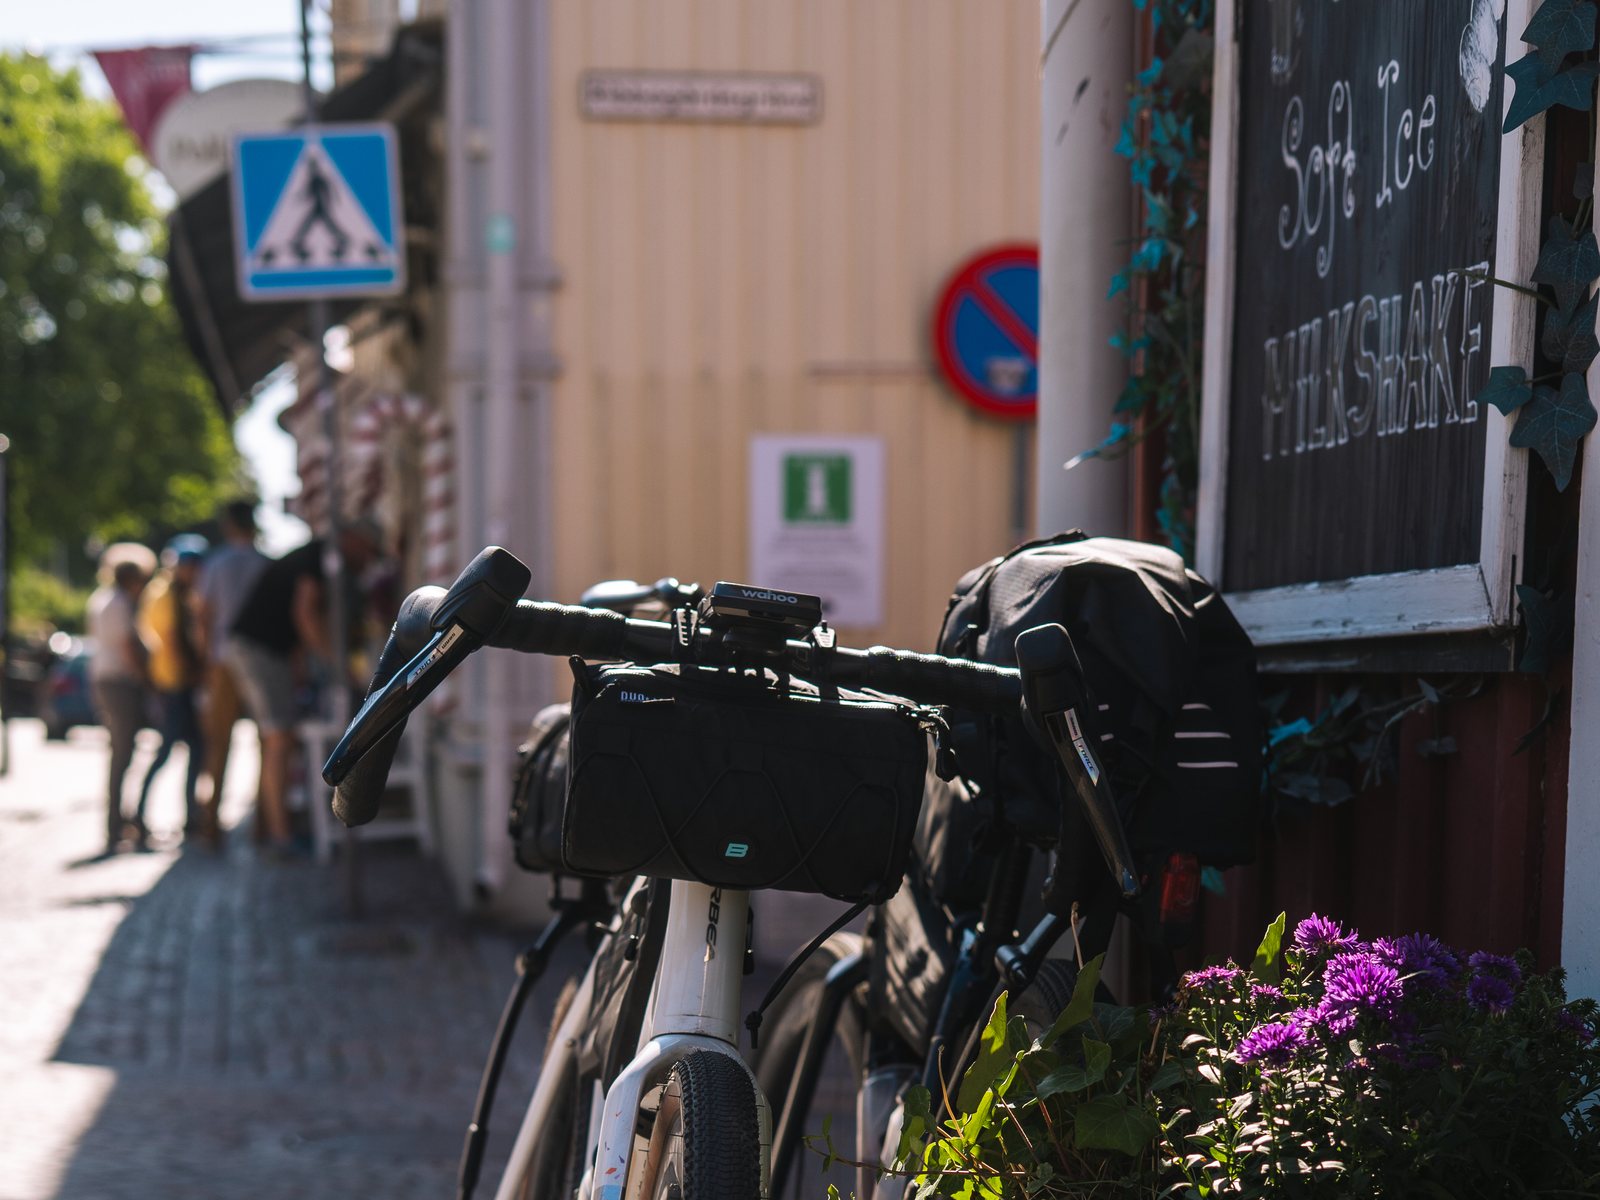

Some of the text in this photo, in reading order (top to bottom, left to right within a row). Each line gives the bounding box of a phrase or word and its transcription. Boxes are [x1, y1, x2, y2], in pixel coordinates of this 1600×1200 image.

[1279, 59, 1436, 278] Soft Ice
[1262, 260, 1490, 461] MILKSHAKE
[741, 589, 798, 604] wahoo
[704, 886, 721, 962] RBEA
